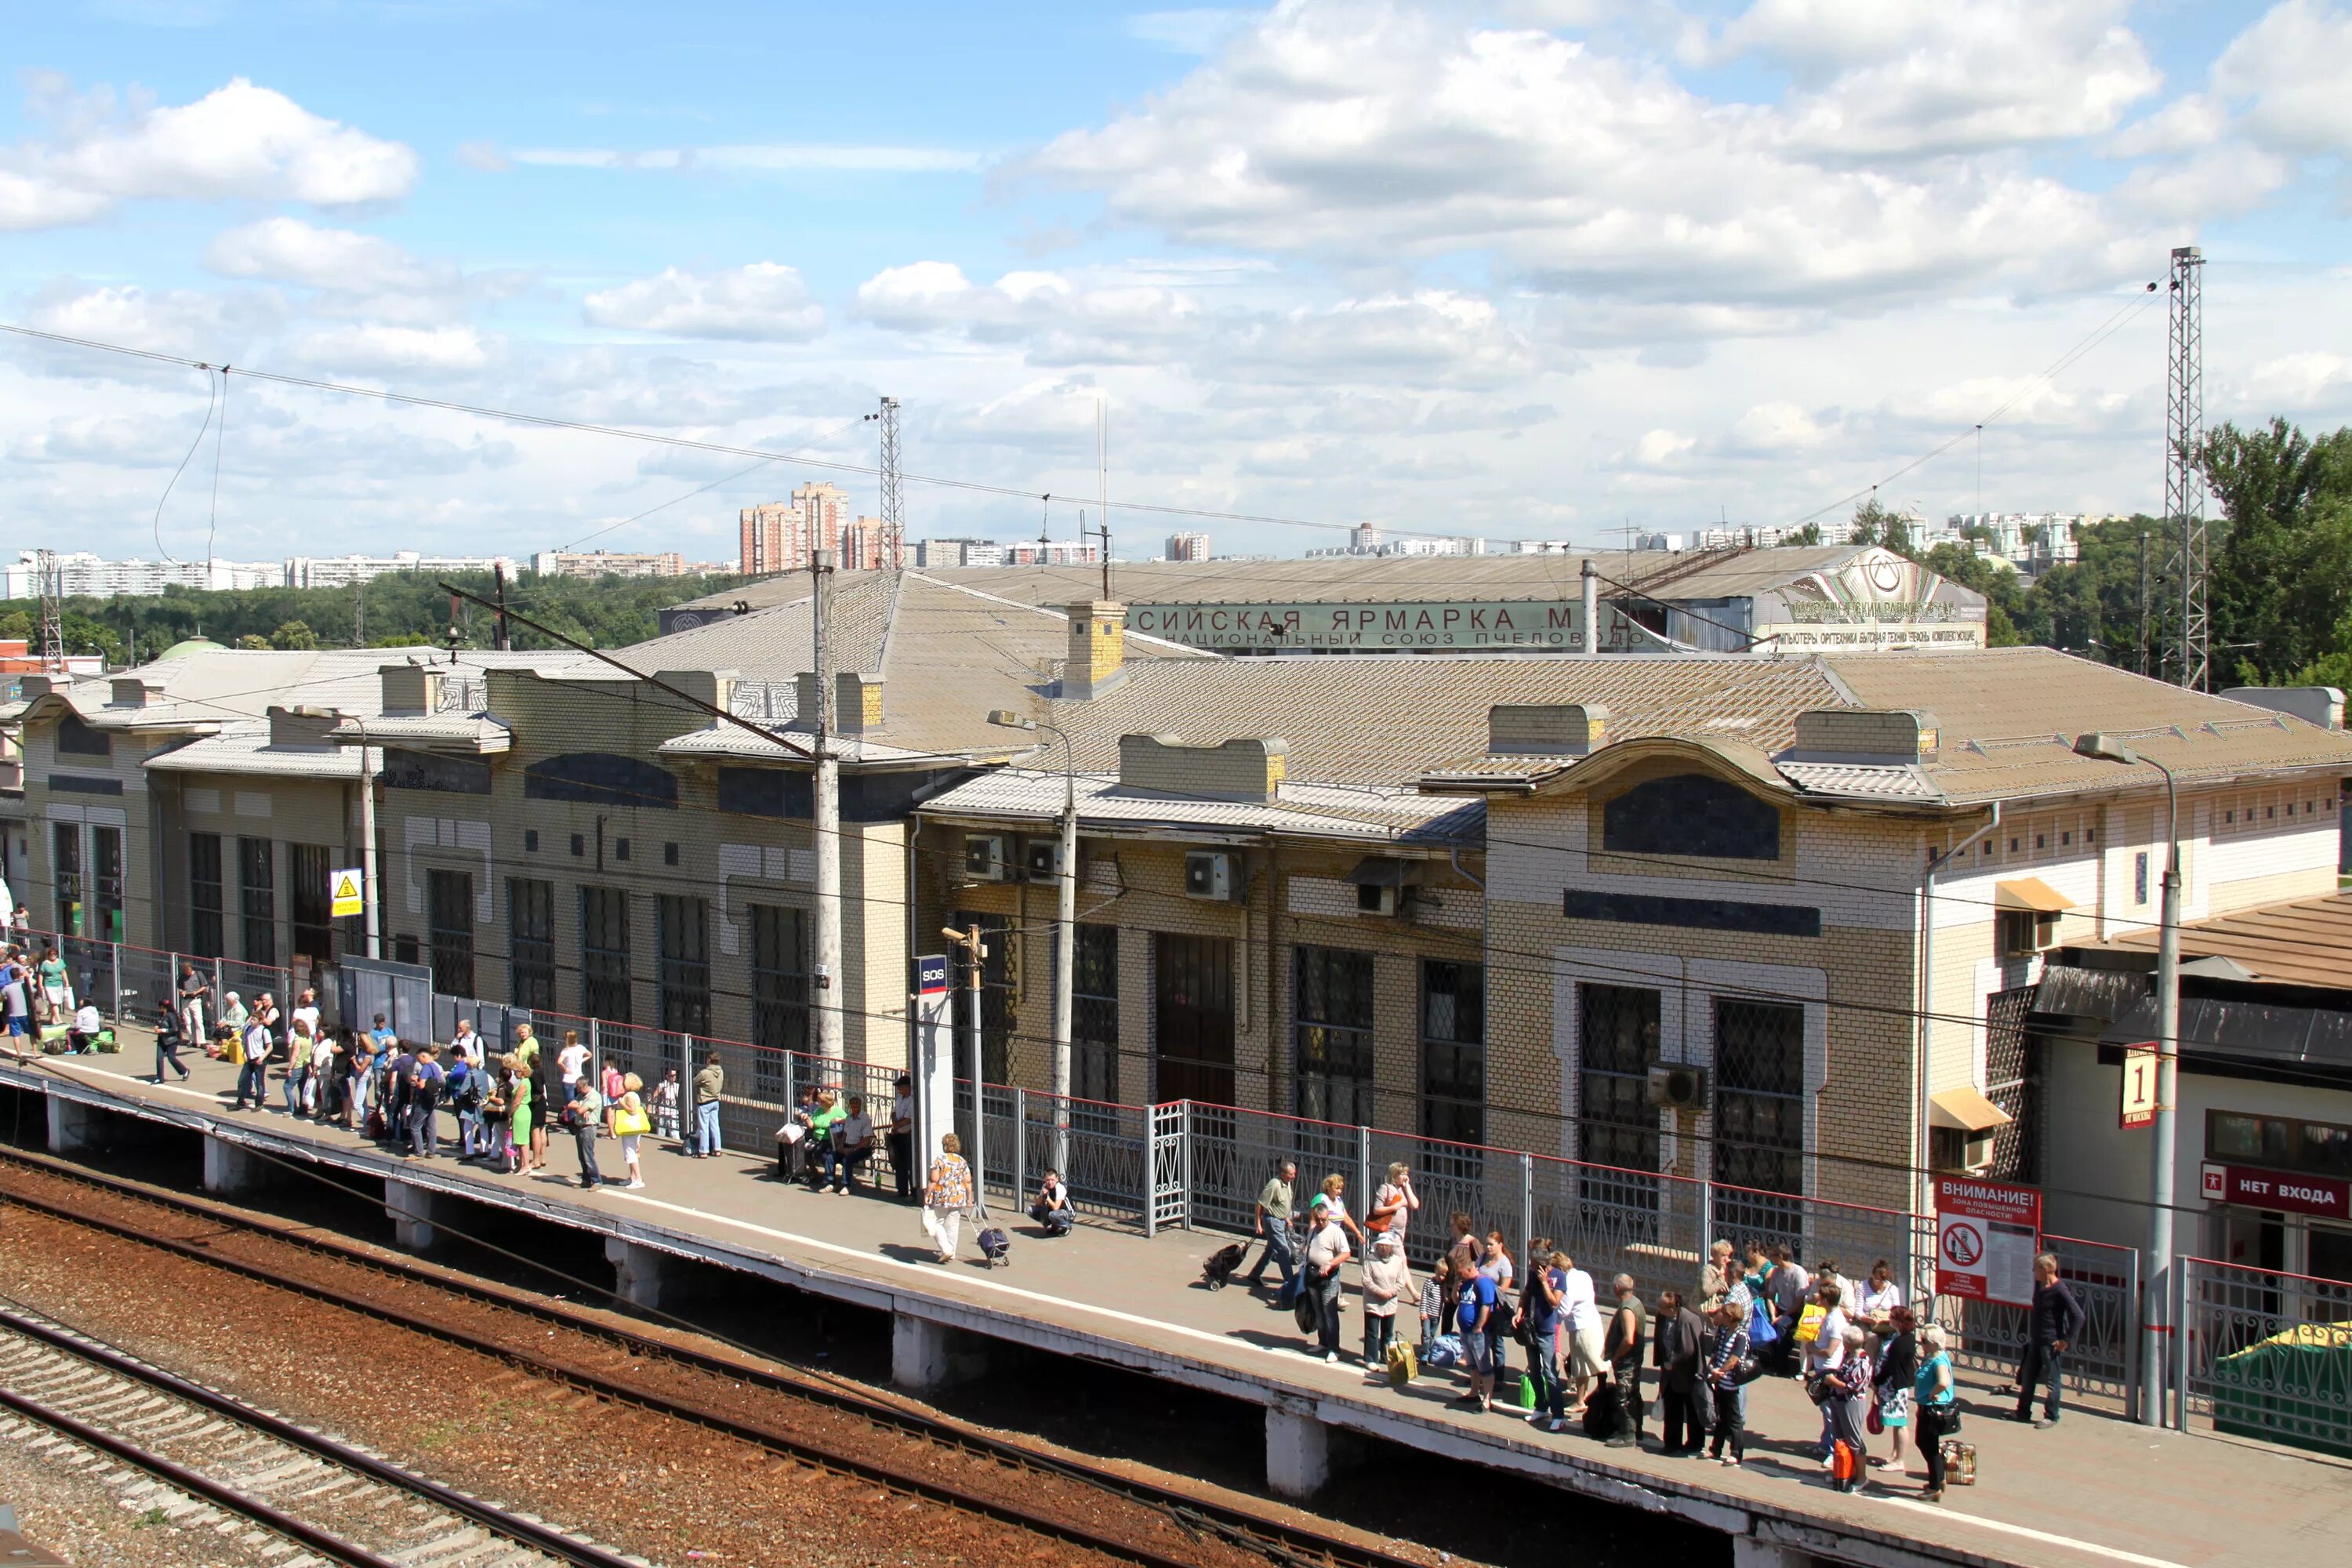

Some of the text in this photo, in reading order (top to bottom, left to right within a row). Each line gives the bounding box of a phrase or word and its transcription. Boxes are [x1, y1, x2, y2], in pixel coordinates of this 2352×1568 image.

[1331, 609, 1515, 630] ЯРМАРКА
[1381, 633, 1454, 645] СОЮЗ
[923, 968, 944, 982] SOS
[2133, 1064, 2146, 1105] 1
[1942, 1181, 2034, 1207] ВНИМАНИЕ!
[2240, 1179, 2336, 1204] НЕТ ВХОДА
[1952, 1197, 2027, 1214] ЗОНА ПОВЫШЕННОЙ
[1965, 1207, 2013, 1220] ОПАСНОСТИ!
